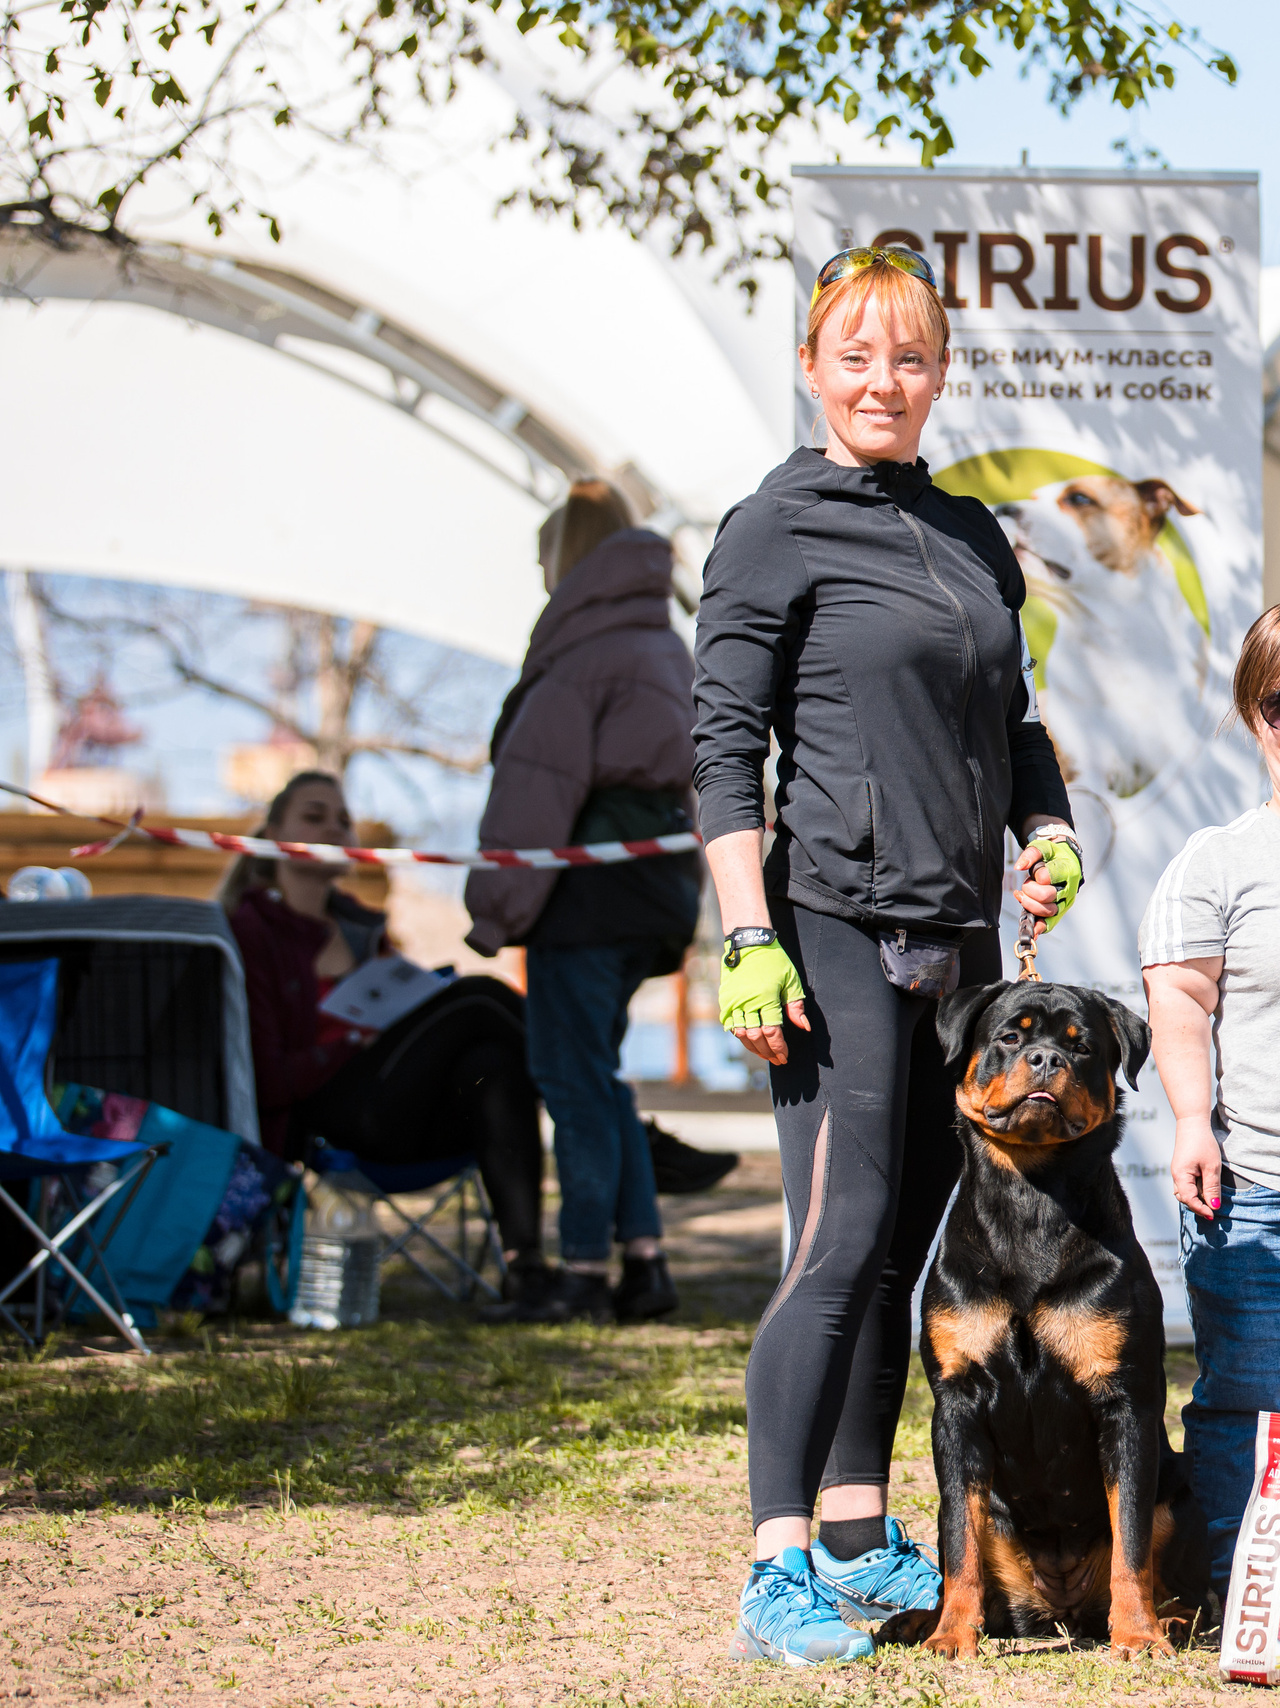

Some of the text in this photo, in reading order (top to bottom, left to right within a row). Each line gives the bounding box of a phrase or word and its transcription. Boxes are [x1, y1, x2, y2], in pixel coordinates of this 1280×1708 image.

[872, 228, 1212, 313] IRIUS
[951, 346, 1212, 370] премиум-класса
[984, 381, 1083, 398] кошек
[1095, 383, 1112, 398] и
[1123, 376, 1212, 400] собак
[1232, 1658, 1265, 1666] PREMIUM
